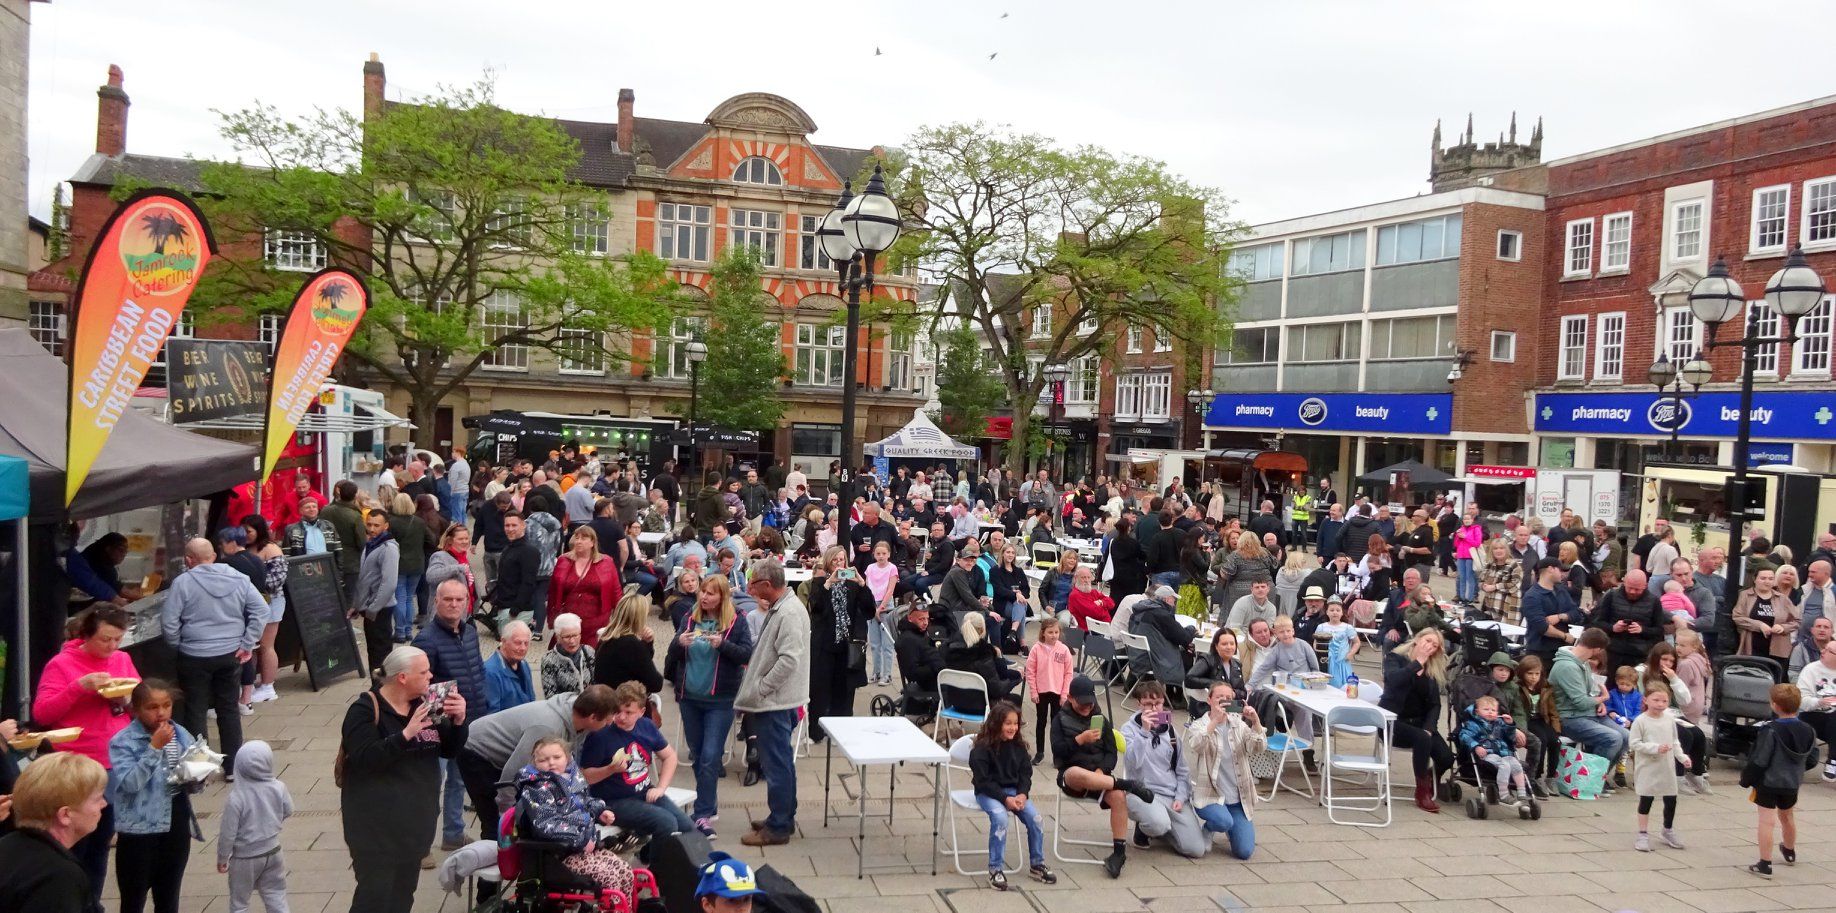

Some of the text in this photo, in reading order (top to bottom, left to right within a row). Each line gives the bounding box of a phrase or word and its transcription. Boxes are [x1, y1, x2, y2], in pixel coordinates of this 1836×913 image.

[133, 268, 194, 299] Catering
[79, 298, 145, 409] CARIBBEAN
[95, 307, 173, 433] STREET FOOD
[173, 392, 236, 414] SPIRITS
[1235, 403, 1389, 421] pharmacy Boots beauty
[1572, 404, 1773, 425] pharmacy Boos beuty
[497, 433, 518, 442] CHIPS
[885, 446, 920, 455] QUALITY
[923, 447, 949, 456] GREEK
[1750, 451, 1790, 461] welcome
